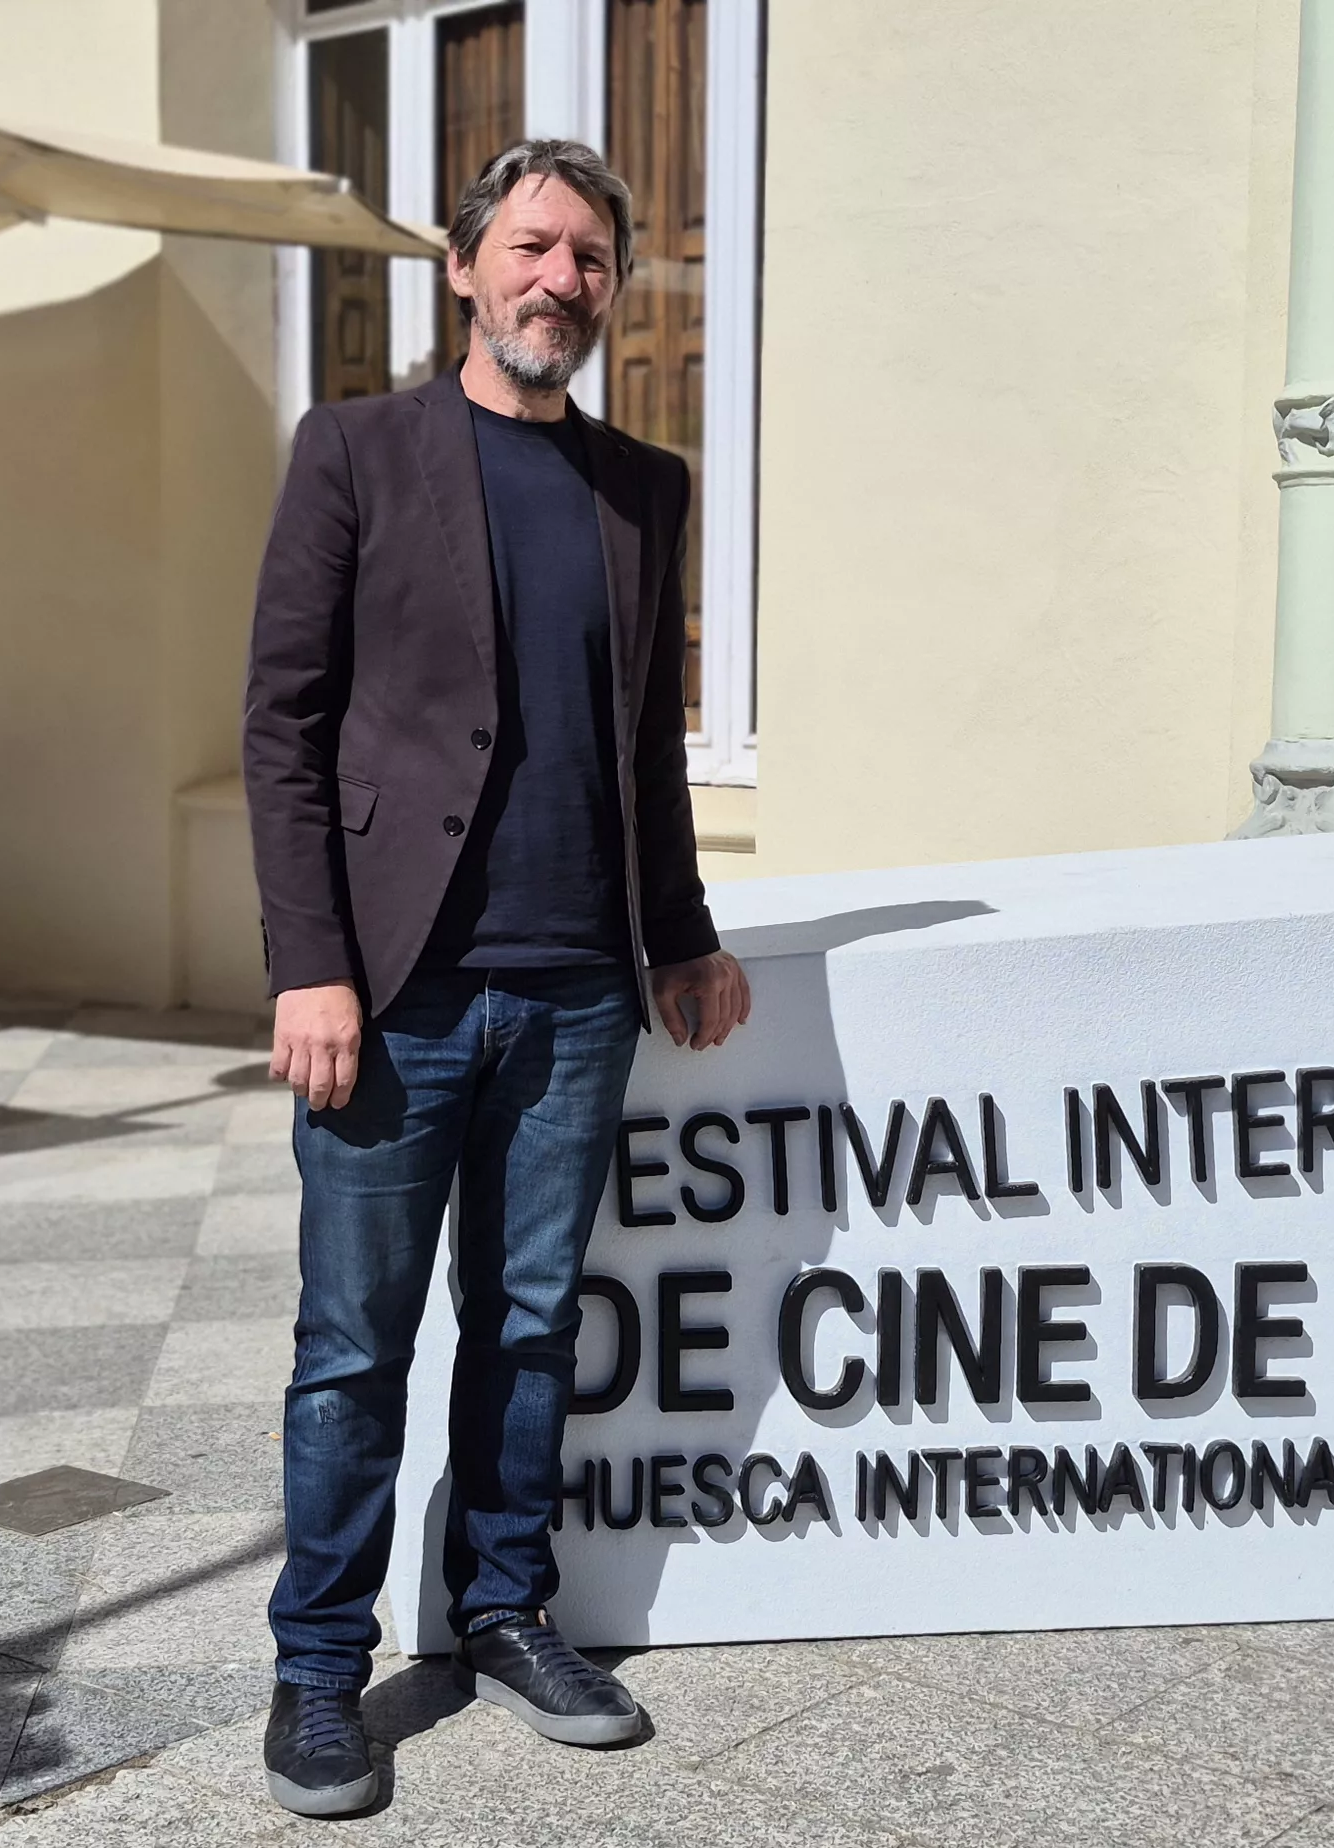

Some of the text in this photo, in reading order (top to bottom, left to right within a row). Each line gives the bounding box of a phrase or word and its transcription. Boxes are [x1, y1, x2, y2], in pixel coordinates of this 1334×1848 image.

[617, 1092, 1040, 1228] ESTIVAL
[567, 1264, 735, 1416] DE
[777, 1265, 1092, 1411] CINE
[1132, 1261, 1308, 1400] DE
[552, 1451, 832, 1532] HUESCA
